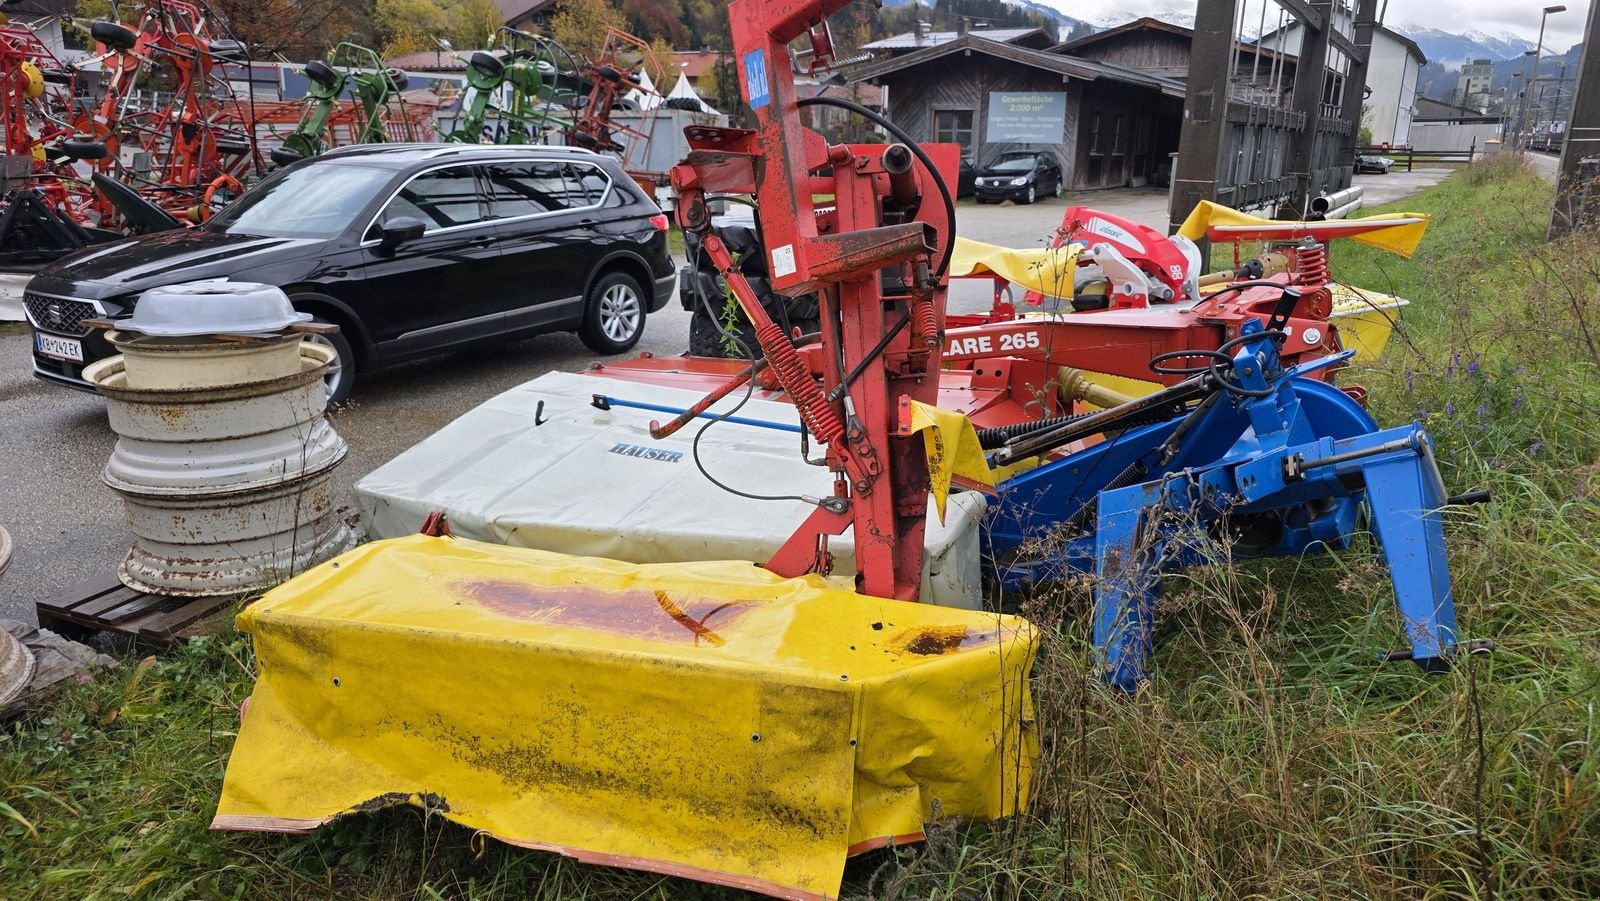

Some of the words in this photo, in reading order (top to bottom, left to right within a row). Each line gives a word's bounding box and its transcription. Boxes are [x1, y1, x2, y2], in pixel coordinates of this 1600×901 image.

[1001, 95, 1053, 103] Gewerbefläche
[42, 337, 51, 351] KB
[942, 336, 993, 357] ARE
[1000, 331, 1040, 351] 265
[608, 443, 684, 463] HAUSER
